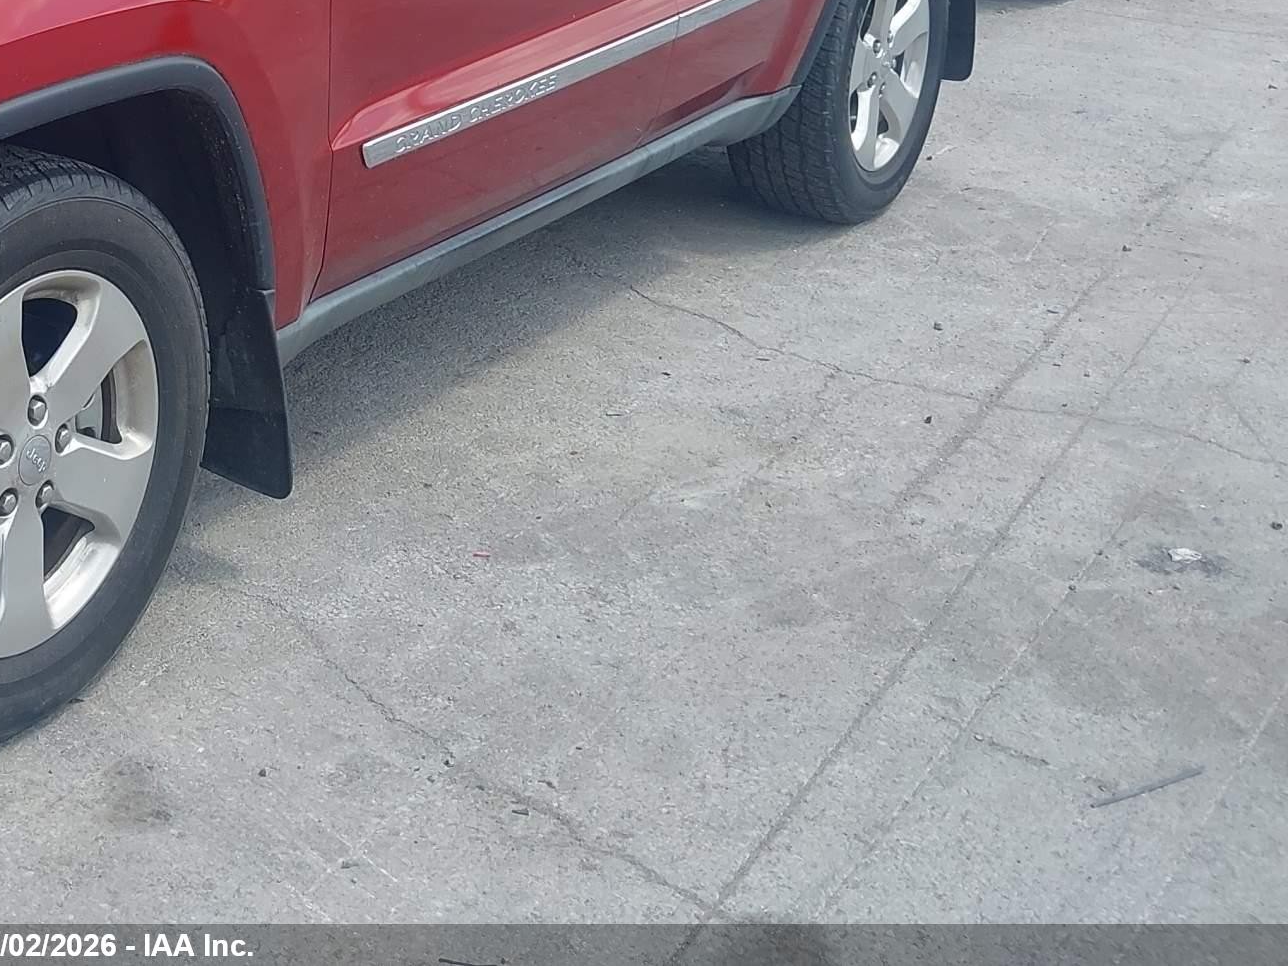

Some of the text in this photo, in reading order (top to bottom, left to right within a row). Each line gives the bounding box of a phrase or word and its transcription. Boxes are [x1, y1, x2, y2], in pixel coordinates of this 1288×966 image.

[395, 74, 557, 153] GRAND CHEROKEE
[25, 447, 47, 473] Jeep
